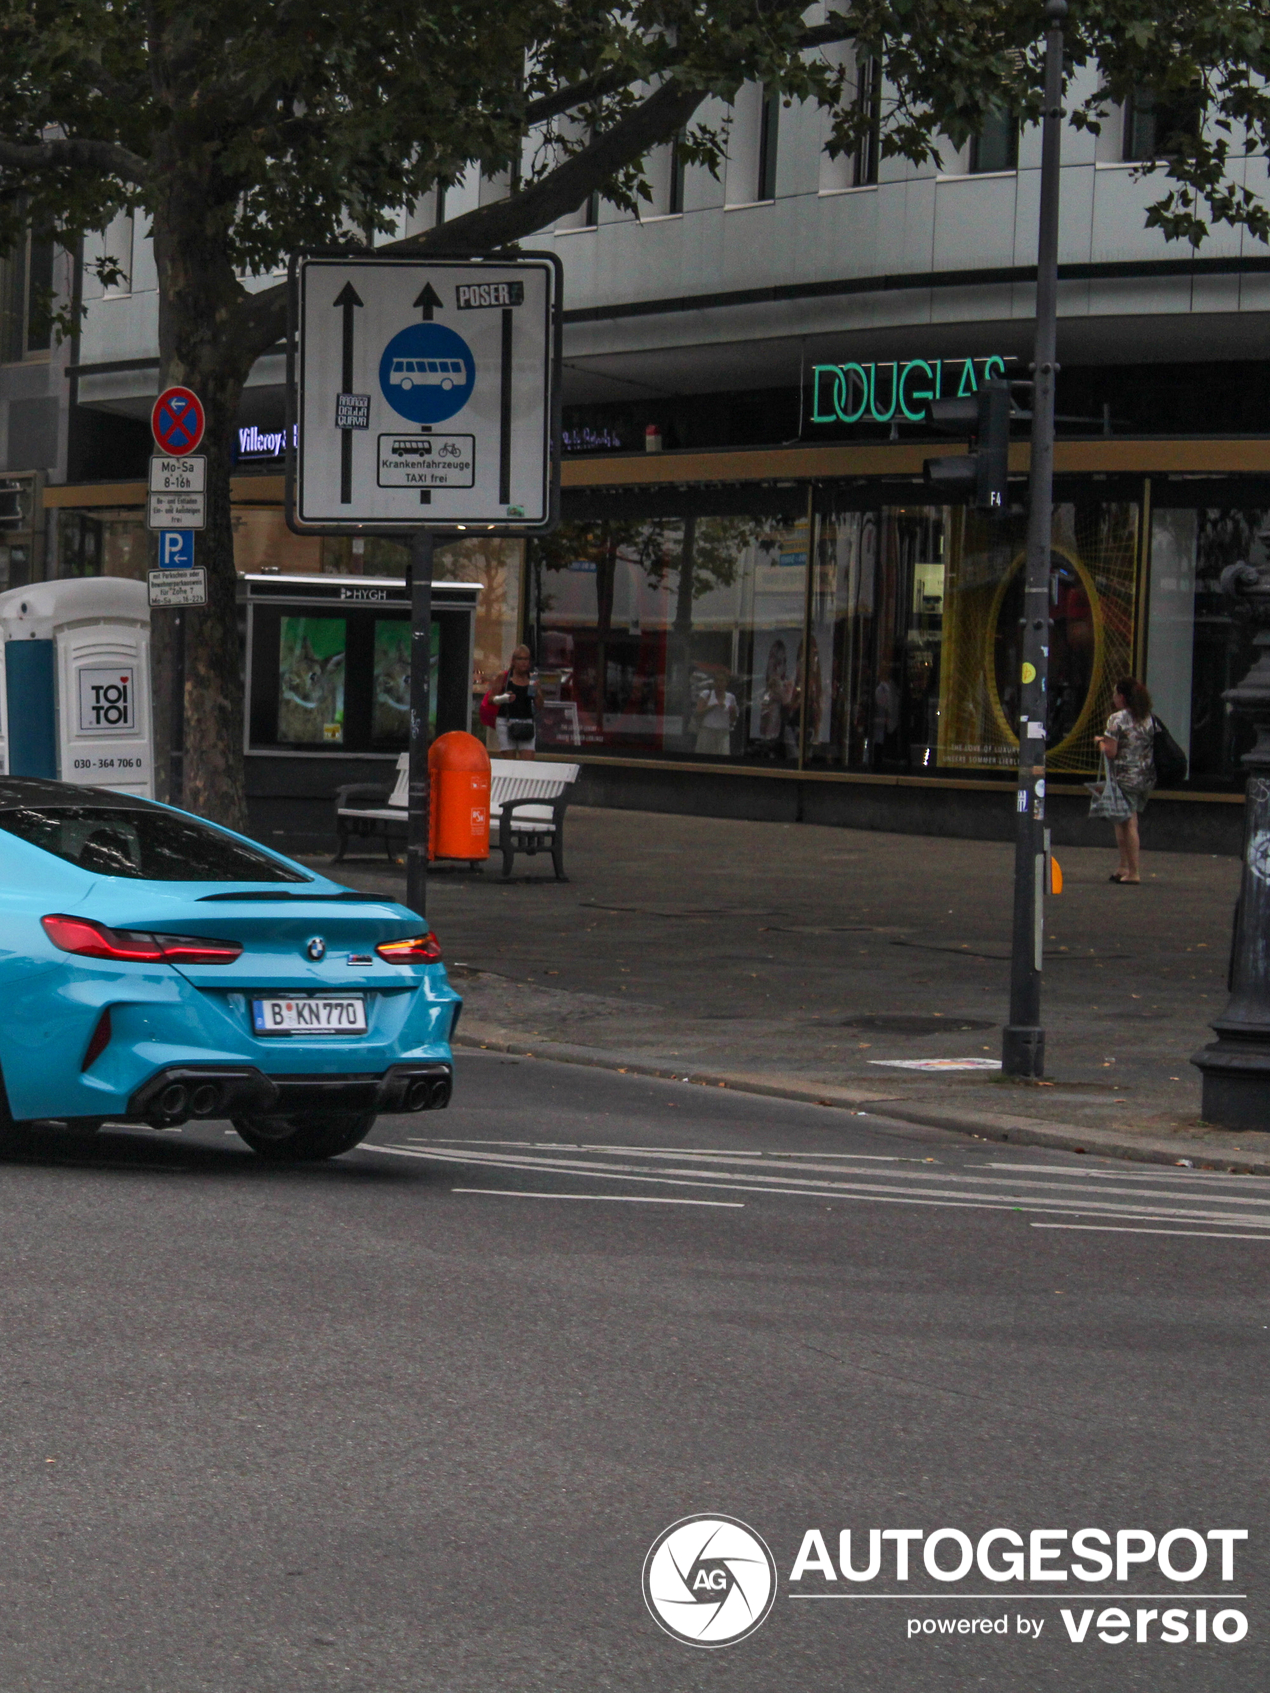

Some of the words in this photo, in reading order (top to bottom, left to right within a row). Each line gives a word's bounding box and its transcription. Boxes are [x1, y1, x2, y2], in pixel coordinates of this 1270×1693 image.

[460, 284, 510, 307] POSER
[238, 426, 282, 456] Villeroy
[162, 462, 194, 472] Mo-Sa
[382, 459, 470, 471] Krankenfahrzeuge
[164, 477, 191, 488] 8-16h
[406, 474, 427, 483] TAXI
[430, 474, 448, 483] frei
[990, 491, 1002, 506] F4
[164, 533, 184, 564] P
[353, 589, 387, 600] HYGH
[91, 684, 128, 704] TOI
[92, 705, 128, 724] TOI
[74, 759, 90, 768] 030
[98, 758, 114, 768] 364
[117, 758, 134, 768] 706
